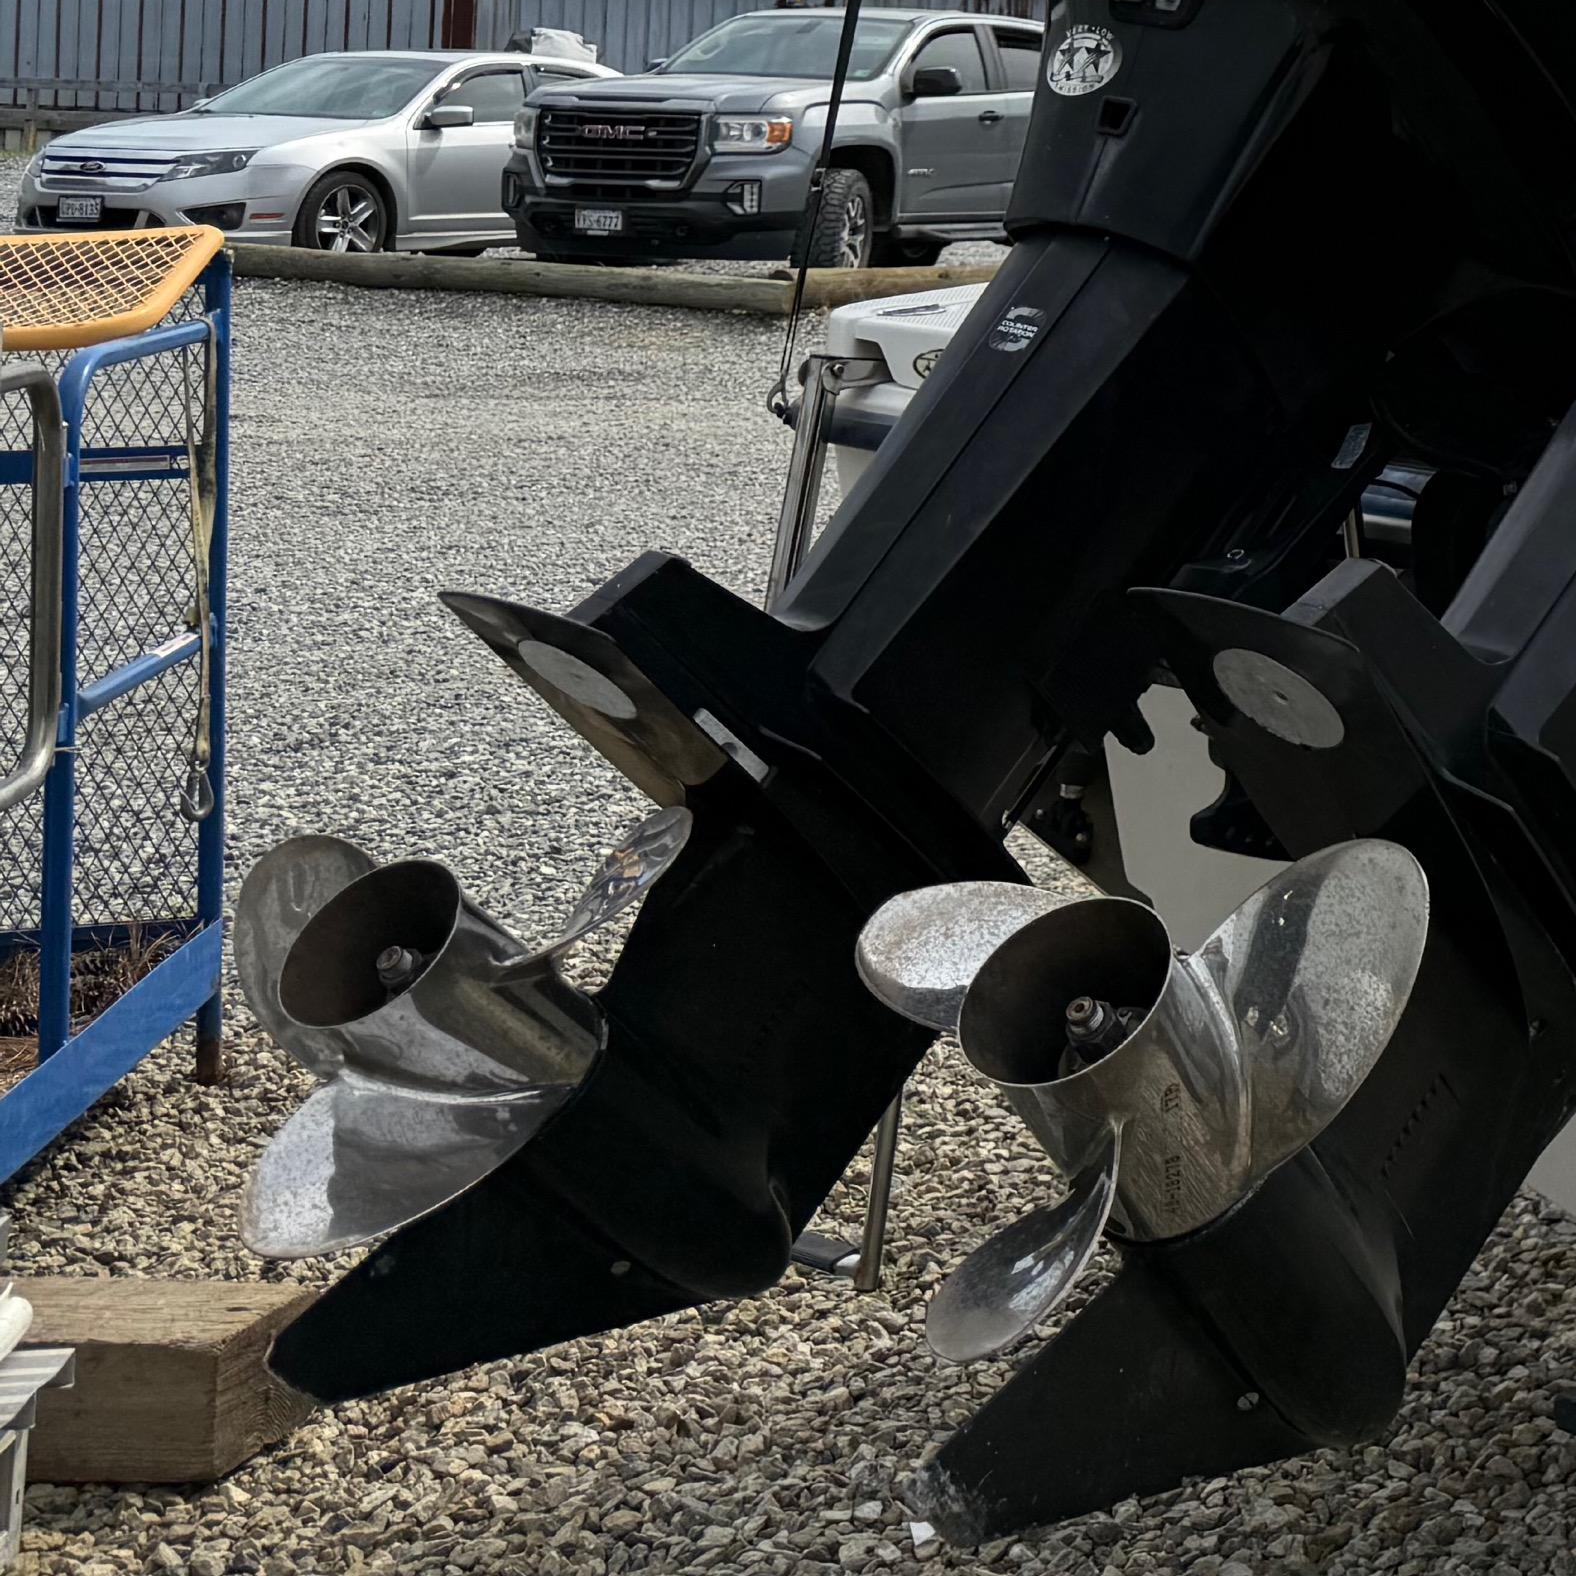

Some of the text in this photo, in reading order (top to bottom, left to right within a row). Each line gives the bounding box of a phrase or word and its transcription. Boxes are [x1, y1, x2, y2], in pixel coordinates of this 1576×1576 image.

[583, 125, 646, 140] GMC
[997, 326, 1035, 338] ROTATION
[1001, 320, 1039, 332] COUNTER
